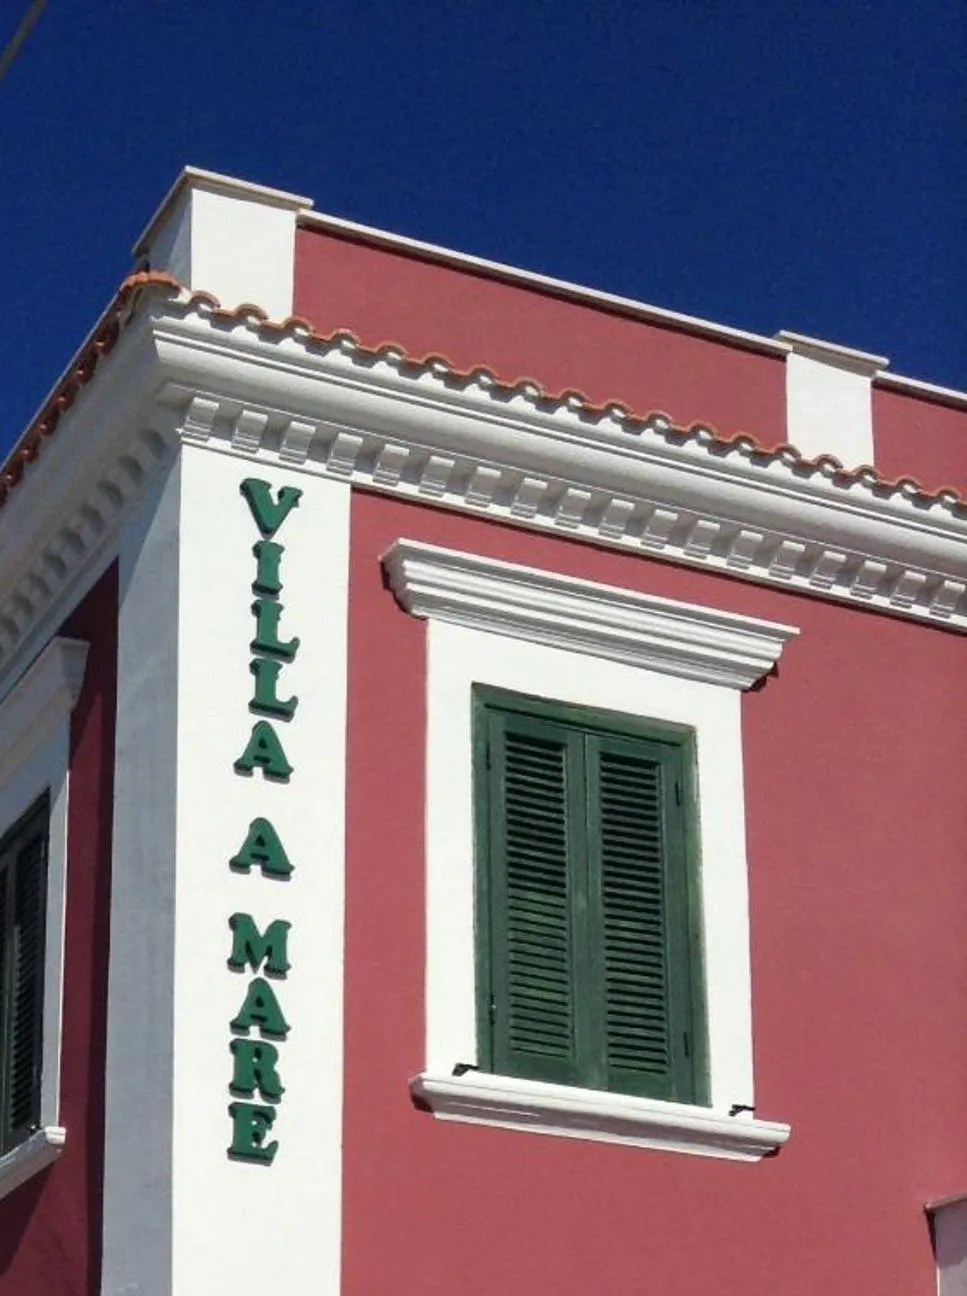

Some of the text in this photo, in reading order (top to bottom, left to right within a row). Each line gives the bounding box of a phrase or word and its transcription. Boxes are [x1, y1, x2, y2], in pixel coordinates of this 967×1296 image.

[227, 477, 303, 1167] VILLA A MARE
